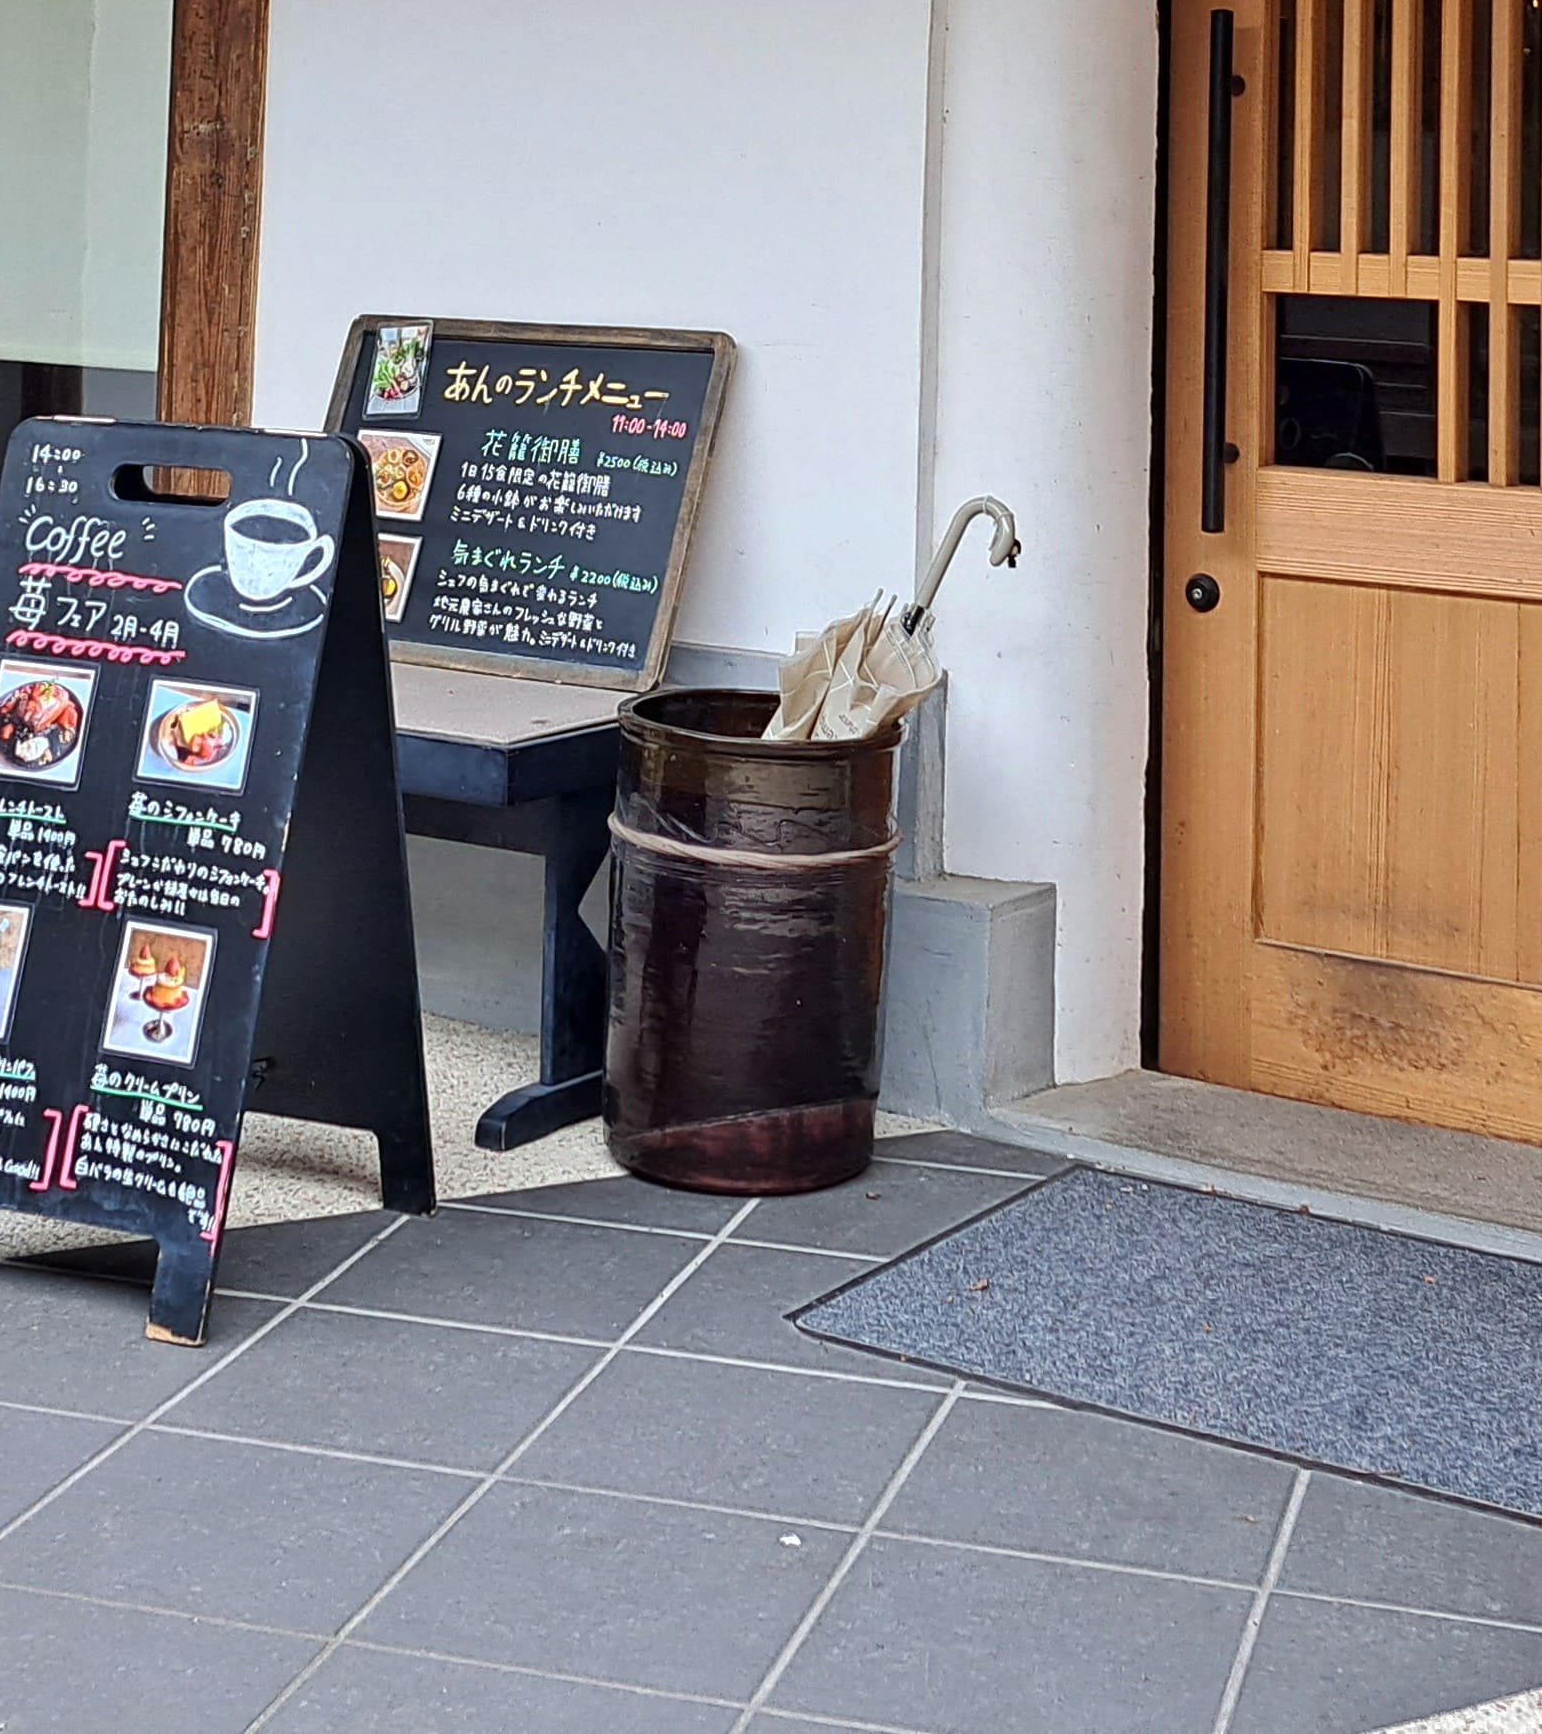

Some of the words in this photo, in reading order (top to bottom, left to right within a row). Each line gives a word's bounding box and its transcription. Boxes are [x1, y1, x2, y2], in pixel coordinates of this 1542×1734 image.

[444, 360, 670, 409] あんのランチメニュー
[32, 444, 82, 463] 14:00
[25, 516, 127, 564] Coffee
[451, 538, 566, 580] 気まぐれランチ
[9, 575, 108, 630] 苺フェア
[128, 791, 242, 828] 苺のシフォンケーキ
[7, 819, 34, 841] 単品
[187, 826, 215, 850] 単品
[91, 1063, 200, 1103] 苺のクリームプリン
